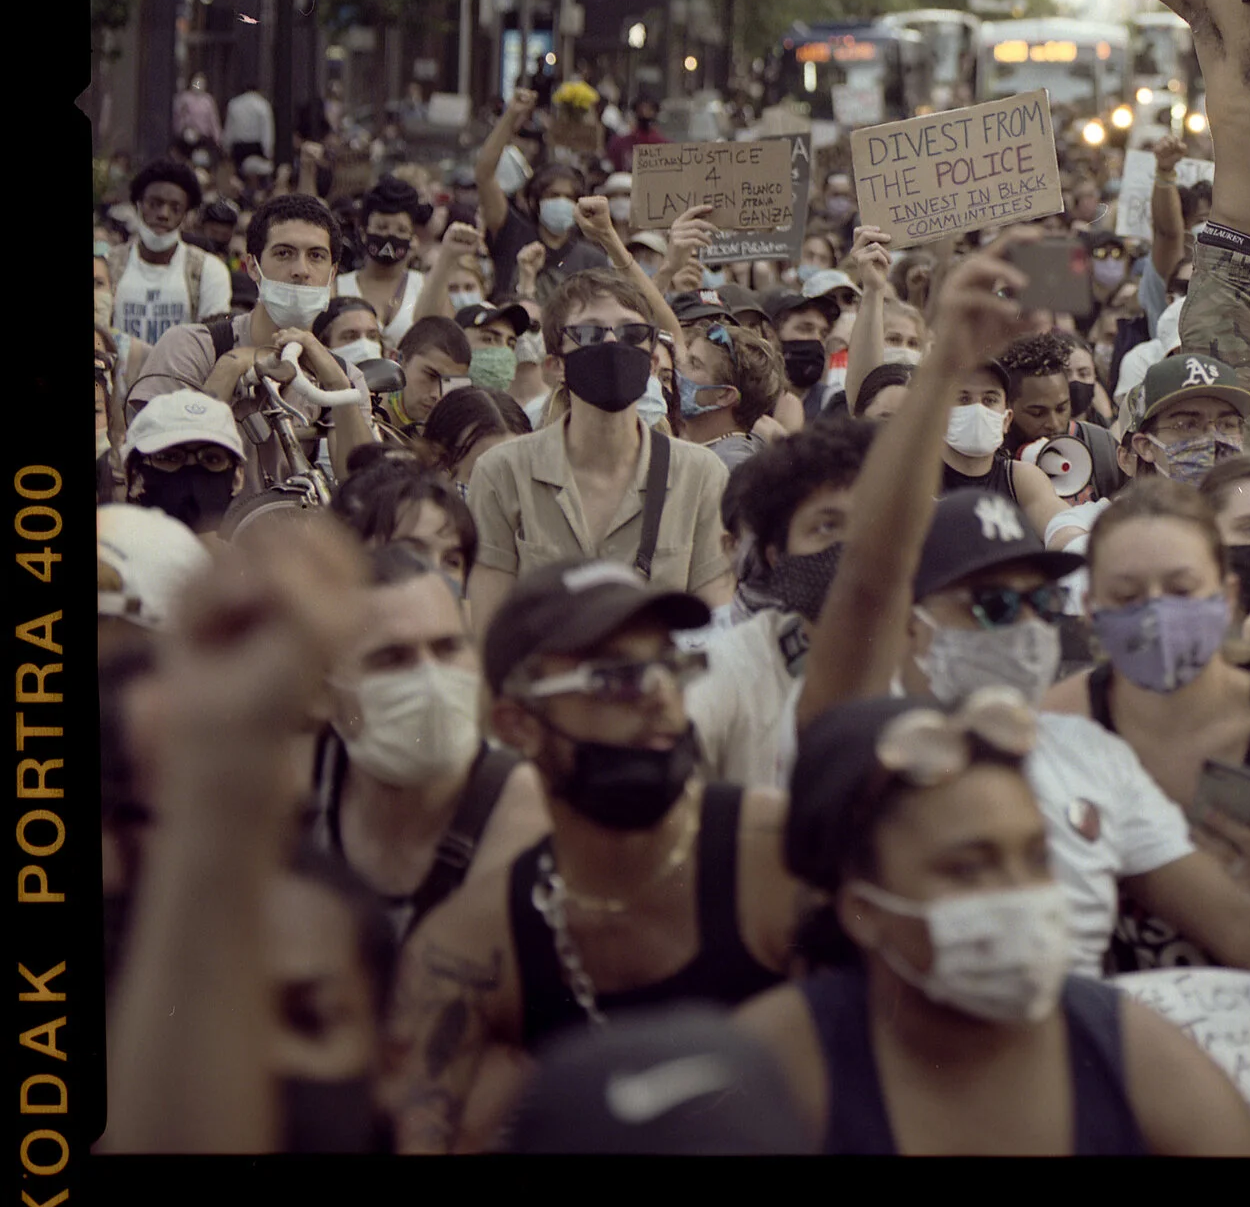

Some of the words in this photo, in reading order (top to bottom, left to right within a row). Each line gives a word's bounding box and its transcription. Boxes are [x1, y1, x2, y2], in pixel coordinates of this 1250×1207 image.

[868, 118, 973, 166] DIVEST
[982, 101, 1045, 144] FROM
[681, 147, 763, 165] JUSTICE
[705, 166, 722, 188] 4
[859, 167, 921, 202] THE
[935, 144, 1034, 188] POLICE
[647, 192, 736, 220] LAYLEEN
[889, 193, 959, 222] INVEST
[968, 188, 991, 207] IN
[997, 174, 1047, 199] BLACK
[738, 205, 793, 226] GANZA
[1213, 229, 1245, 245] LAUREN
[124, 319, 141, 338] IS
[146, 319, 181, 346] NO
[1181, 357, 1220, 388] A's
[13, 464, 63, 583] 400
[15, 609, 65, 903] PORTRA
